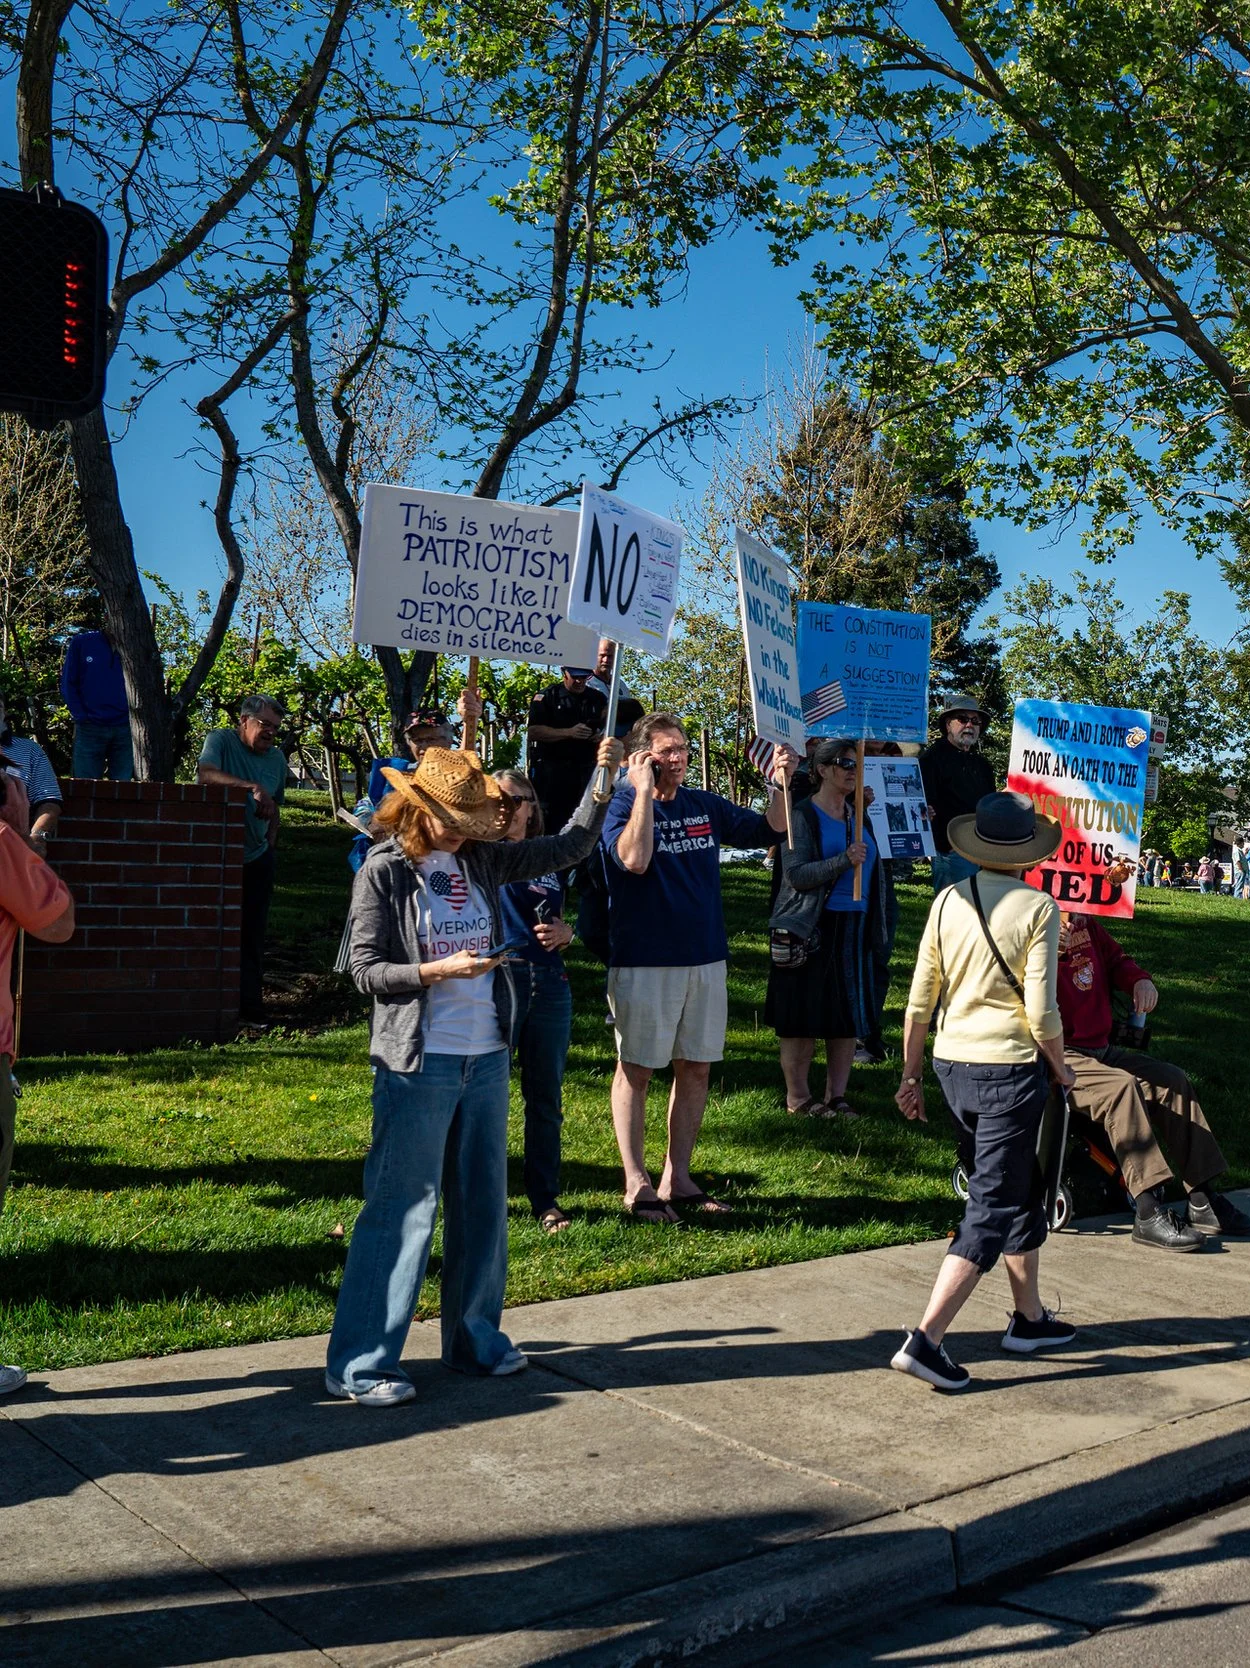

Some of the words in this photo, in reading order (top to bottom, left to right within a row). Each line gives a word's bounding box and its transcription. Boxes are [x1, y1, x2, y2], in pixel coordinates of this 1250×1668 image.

[400, 503, 448, 531] This
[459, 516, 478, 536] is
[490, 517, 553, 546] what
[403, 533, 570, 583] PATRIOTISM
[583, 512, 641, 616] NO
[422, 570, 480, 601] looks
[490, 578, 559, 609] like!!
[743, 552, 760, 586] NO
[761, 565, 790, 613] Kings
[397, 598, 563, 640] DEMOCRACY
[746, 592, 762, 627] NO
[764, 605, 794, 648] Felons
[807, 612, 834, 633] THE
[845, 616, 926, 641] CONSTITUTION
[401, 624, 441, 642] dies
[447, 629, 463, 646] in
[470, 632, 563, 657] silence...
[845, 641, 856, 653] IS
[868, 643, 893, 658] NOT
[760, 645, 771, 671] in
[772, 650, 790, 681] the
[820, 663, 828, 678] A
[754, 673, 779, 711] White
[778, 687, 803, 722] House
[1036, 717, 1068, 741] TRUMP
[1071, 721, 1091, 744] AND
[1093, 725, 1099, 745] I
[1099, 726, 1126, 748] BOTH
[1022, 750, 1051, 776] TOOK
[1053, 756, 1068, 778] AN
[1071, 757, 1100, 782] OATH
[1102, 761, 1115, 785] TO
[1118, 763, 1138, 788] THE
[670, 820, 681, 828] NO
[683, 814, 710, 826] KINGS
[657, 835, 715, 854] AMERICA
[1064, 841, 1087, 865] OF
[1091, 842, 1114, 866] US
